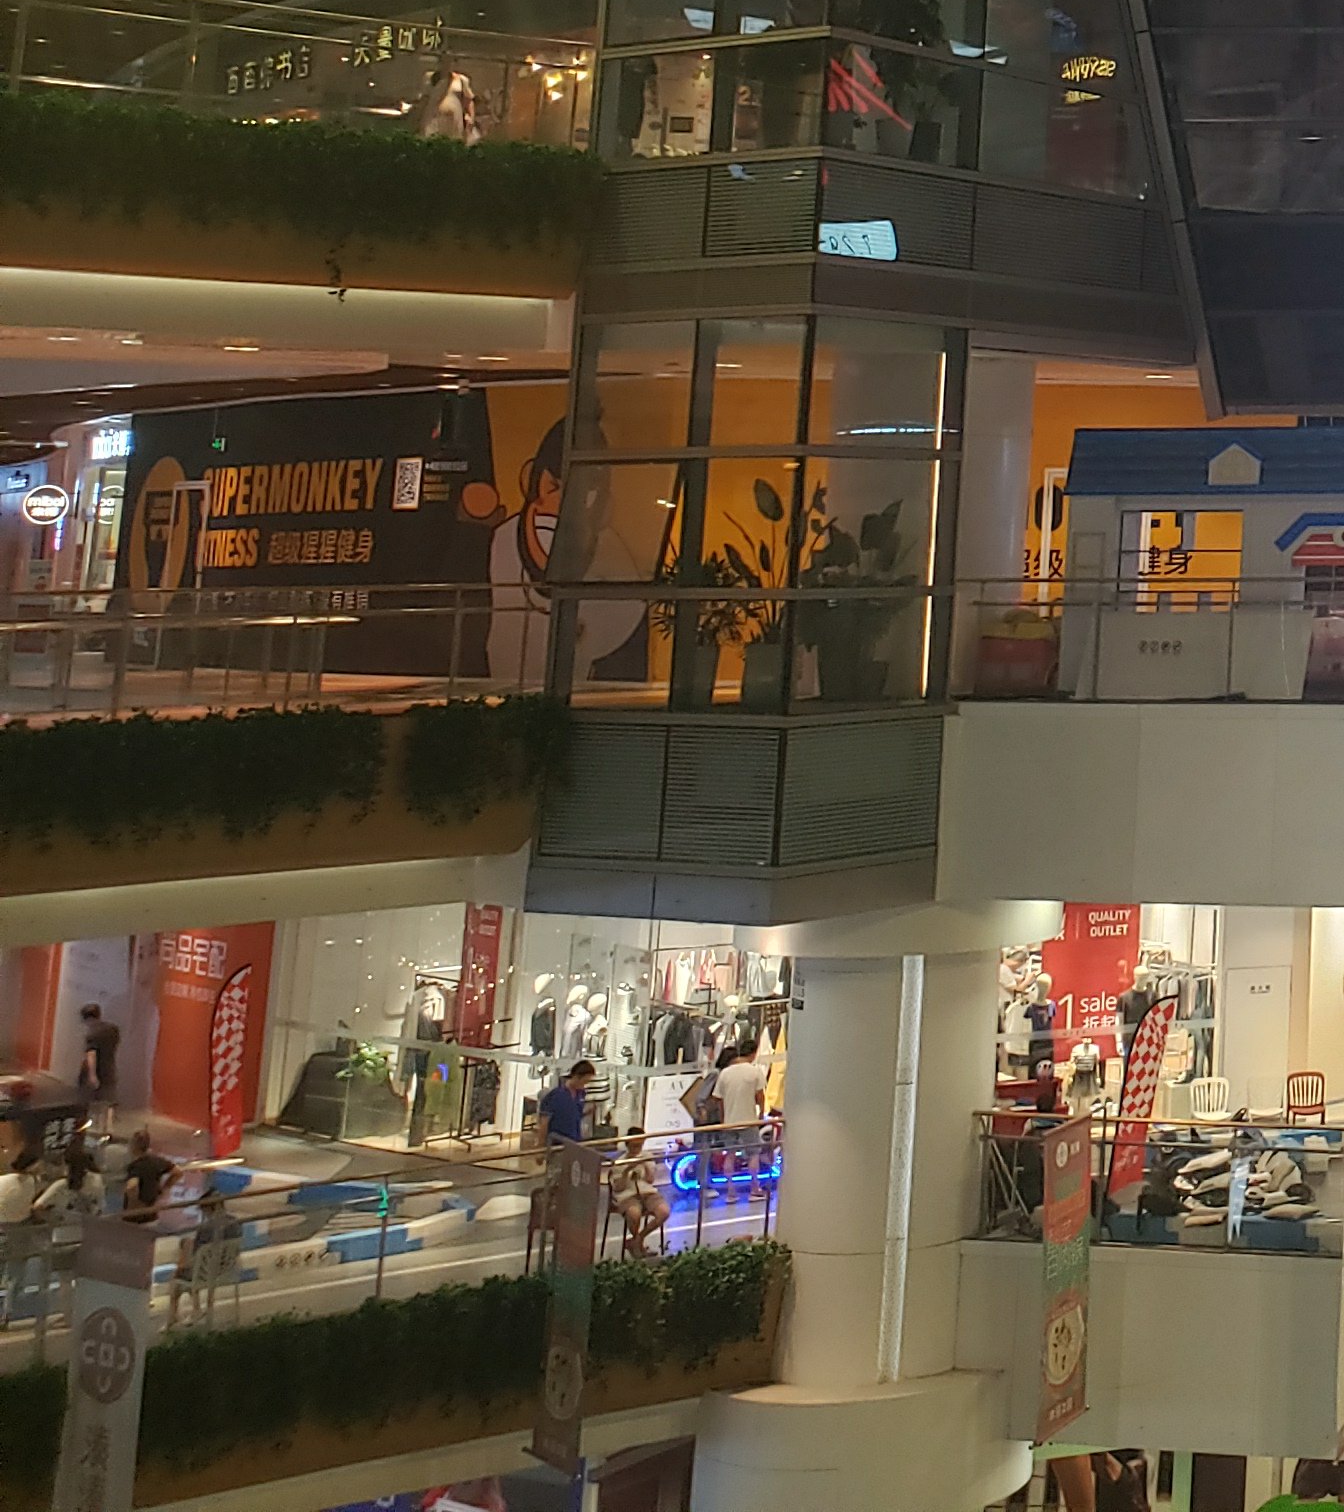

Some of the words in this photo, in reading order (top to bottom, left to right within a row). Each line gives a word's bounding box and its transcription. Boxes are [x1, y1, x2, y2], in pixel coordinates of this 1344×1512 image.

[267, 528, 374, 565] 超级猩猩健身
[1088, 909, 1131, 924] QUALITY
[1090, 924, 1128, 937] OUTLET
[1058, 993, 1073, 1030] 1
[1079, 991, 1118, 1013] sale
